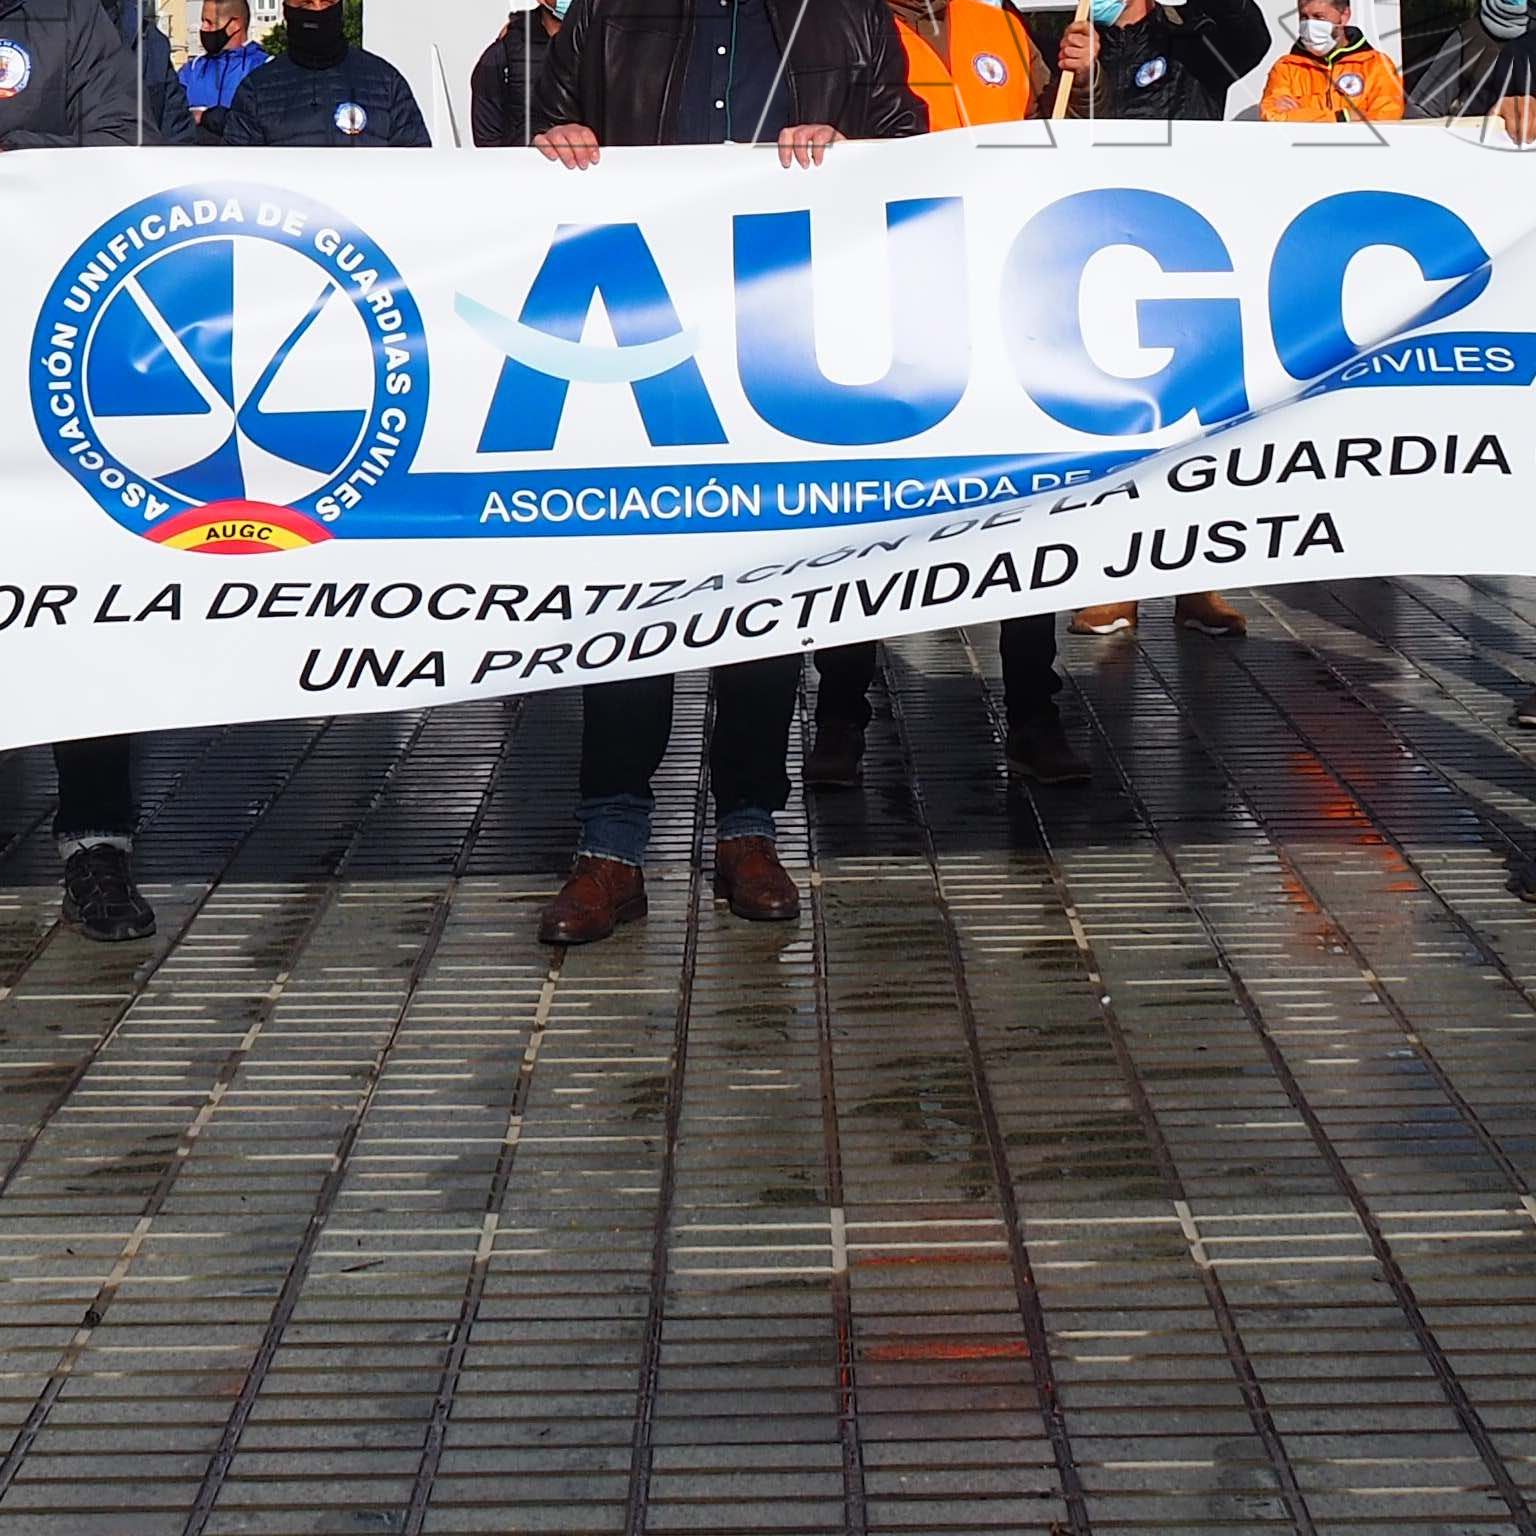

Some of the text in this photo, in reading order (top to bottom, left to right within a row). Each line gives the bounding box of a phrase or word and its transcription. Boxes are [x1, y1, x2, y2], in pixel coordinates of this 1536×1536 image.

[41, 199, 412, 523] ASOCIACIÓN UNIFICADA DE GUARDIAS CIVILES
[476, 186, 1493, 454] AUGC
[1341, 346, 1517, 383] CIVILES
[93, 581, 182, 624] LA
[205, 534, 905, 622] DEMOCRATIZACIÓN
[928, 504, 1025, 543] DE
[1049, 478, 1140, 515] LA
[1166, 434, 1506, 493] GUARDIA
[204, 522, 273, 542] AUGC
[478, 468, 1092, 524] ASOCIACIÓN UNIFICADA DE
[297, 511, 1346, 691] UNA PRODUCTIVIDAD JUSTA
